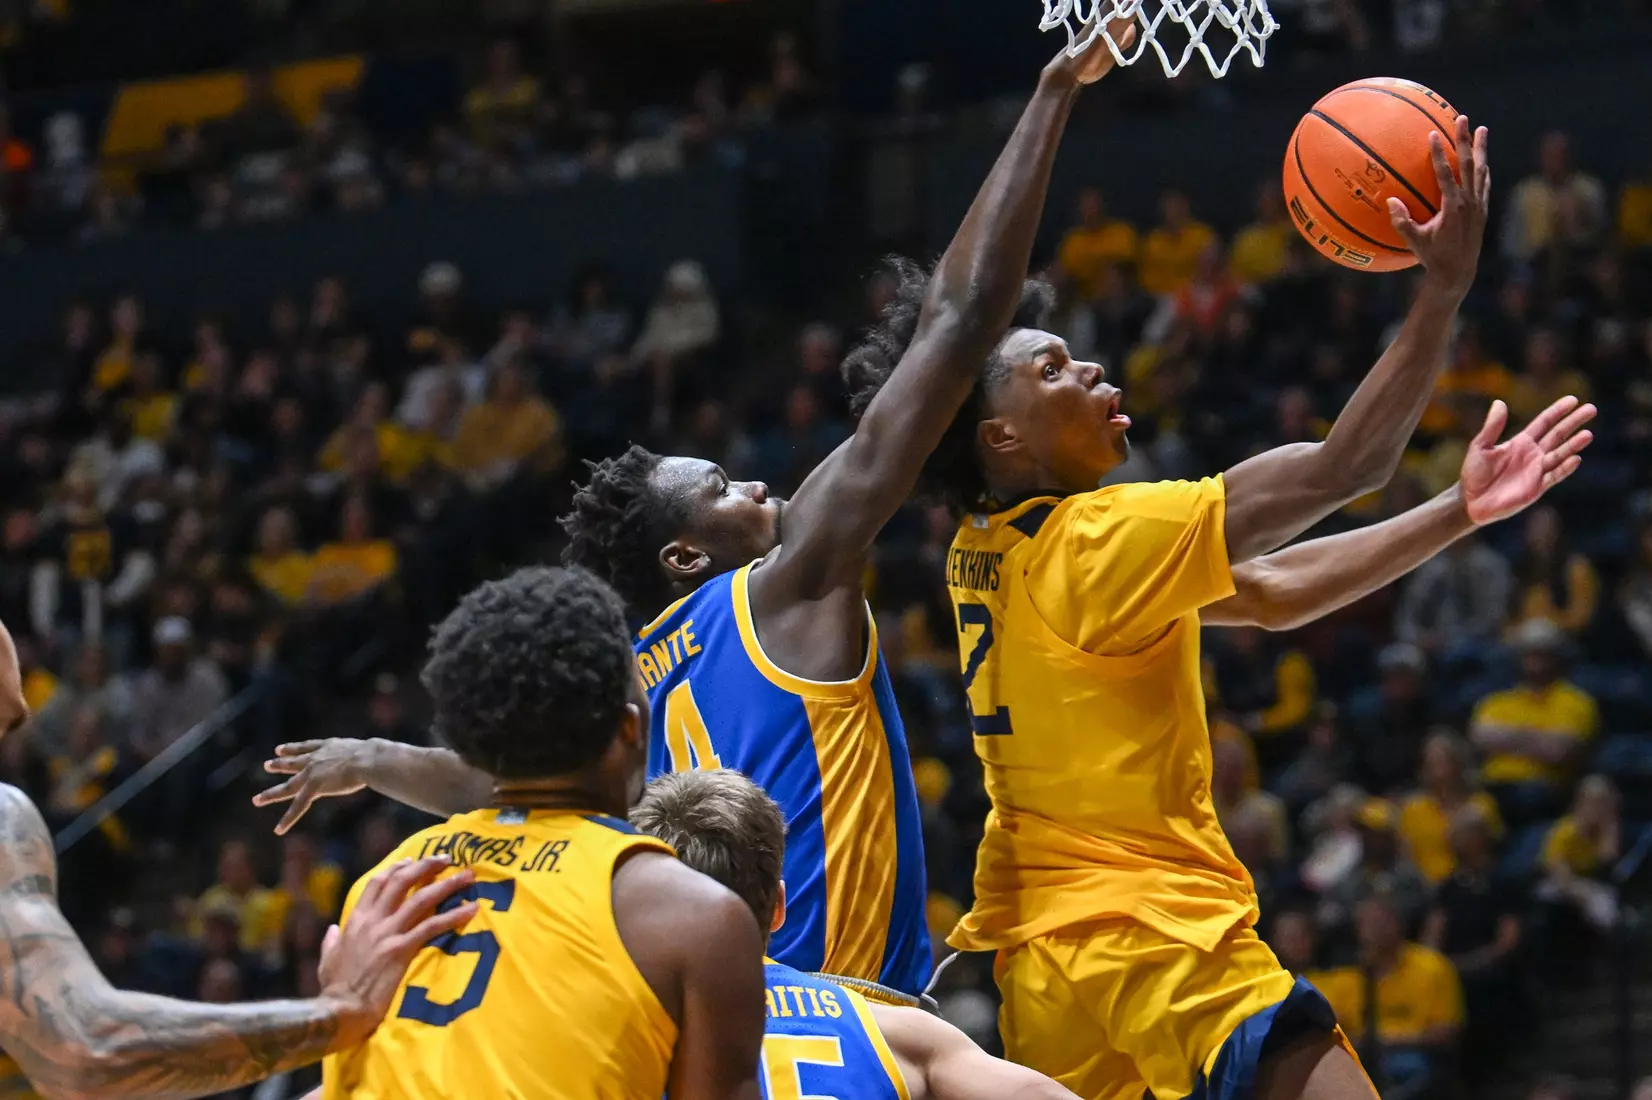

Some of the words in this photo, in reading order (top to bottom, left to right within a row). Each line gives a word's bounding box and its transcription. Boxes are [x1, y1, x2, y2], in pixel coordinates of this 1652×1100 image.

[1290, 196, 1374, 267] ELITE
[637, 618, 702, 691] ANTE
[958, 603, 1014, 735] 2
[664, 678, 722, 774] 4
[417, 831, 526, 868] THOMAS
[520, 839, 571, 874] JR.
[397, 879, 516, 1027] 5
